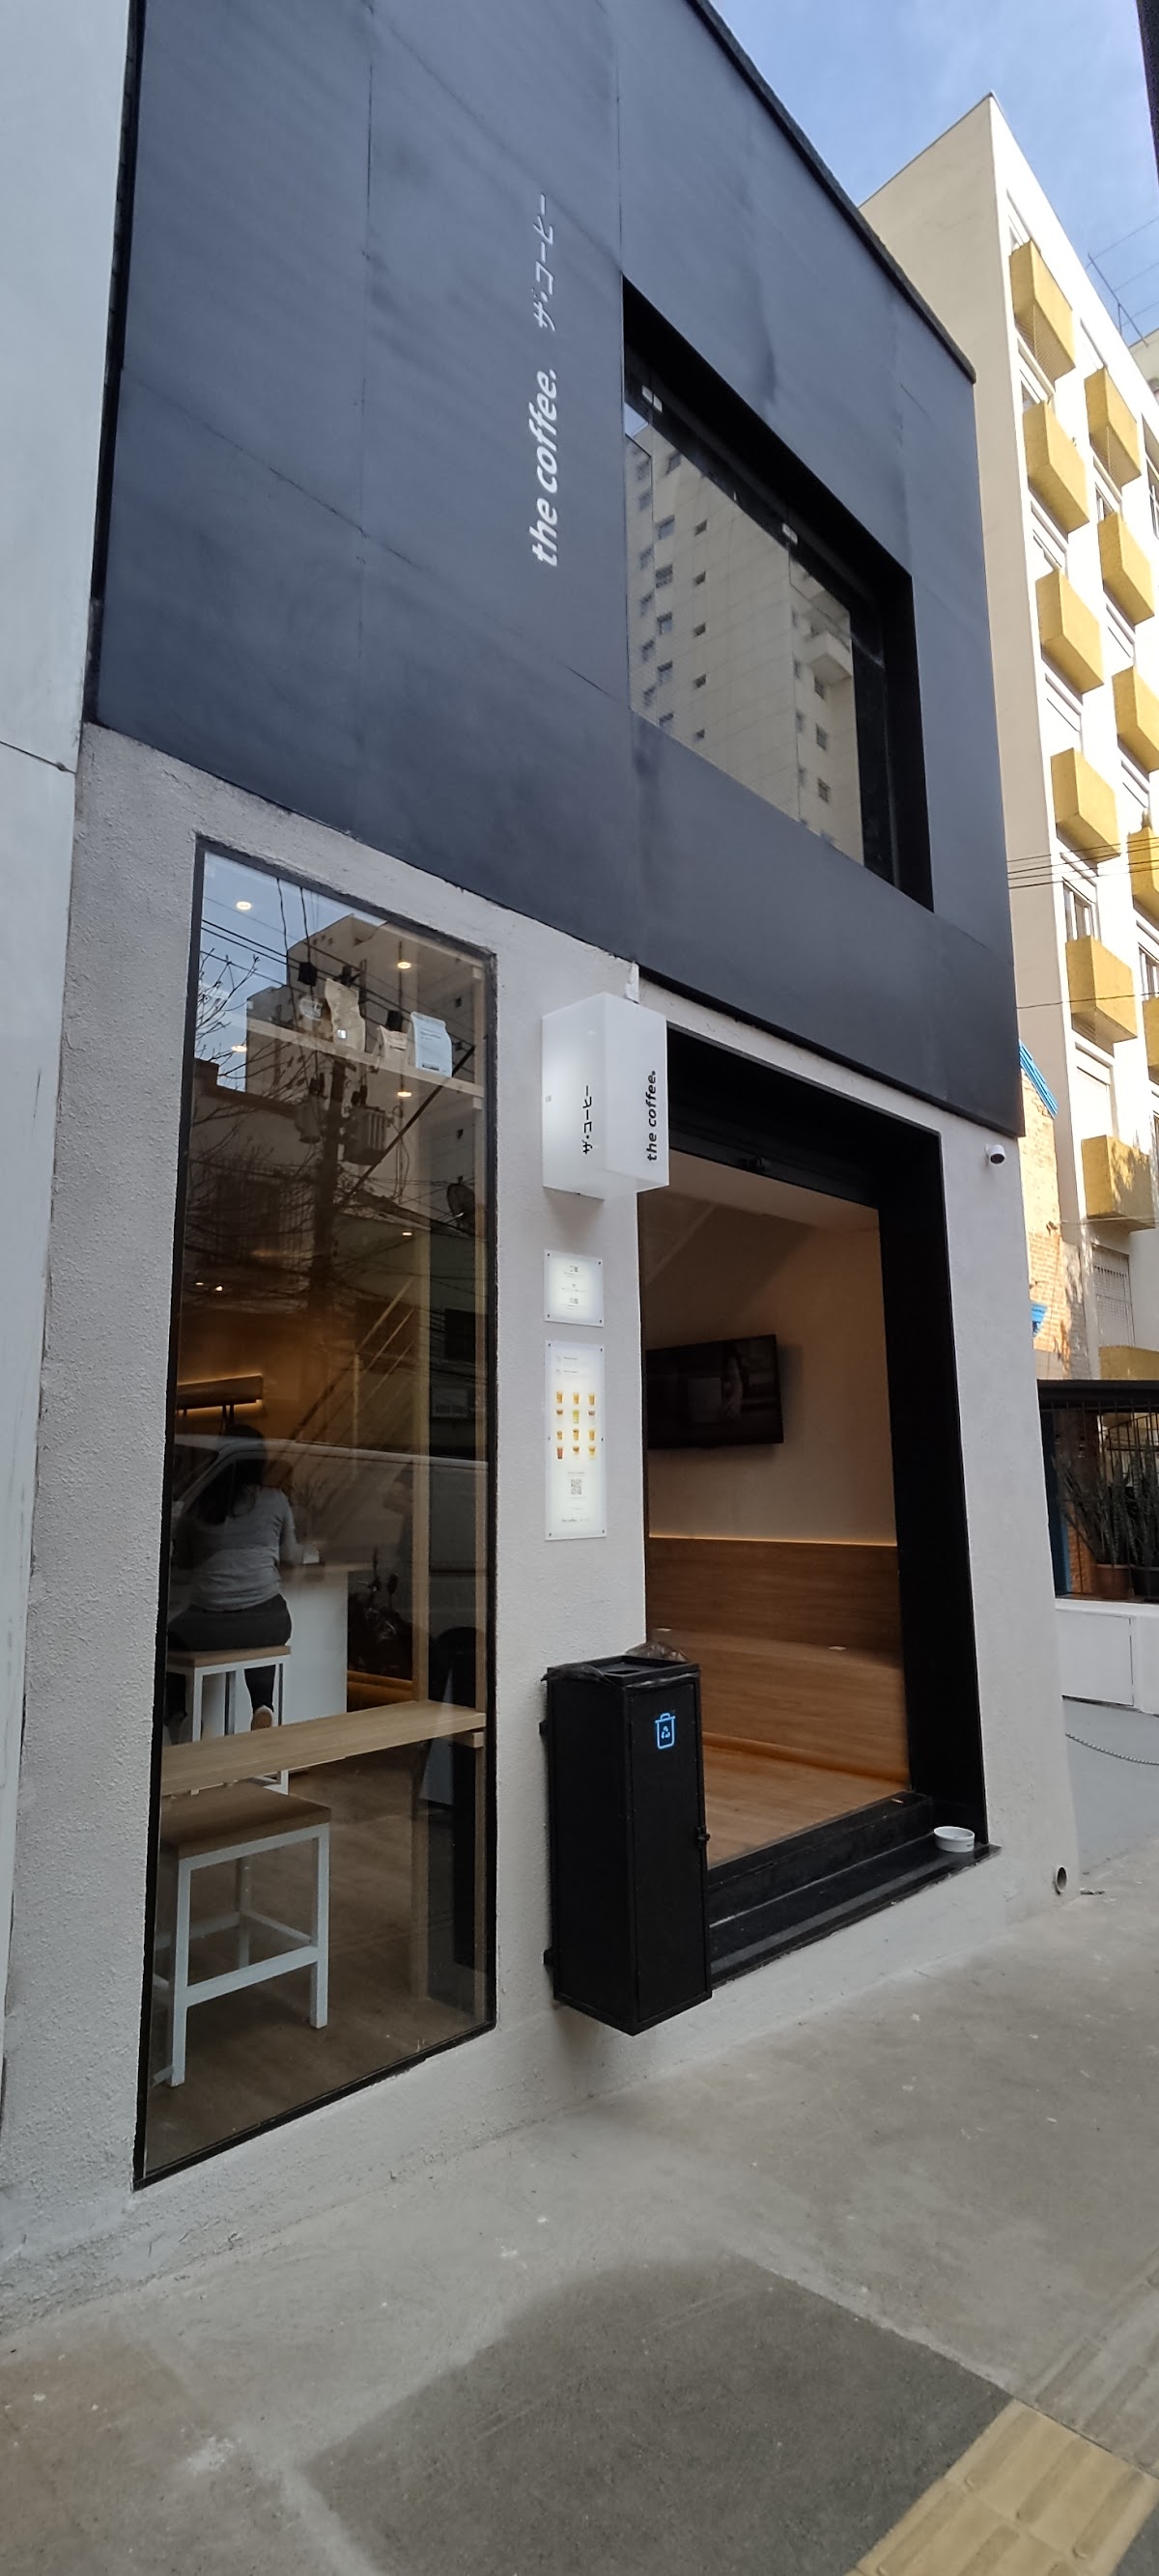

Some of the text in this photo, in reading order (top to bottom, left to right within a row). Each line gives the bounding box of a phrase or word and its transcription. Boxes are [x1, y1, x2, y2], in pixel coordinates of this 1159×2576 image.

[529, 369, 558, 568] the coffee.
[645, 1070, 658, 1162] the coffee.
